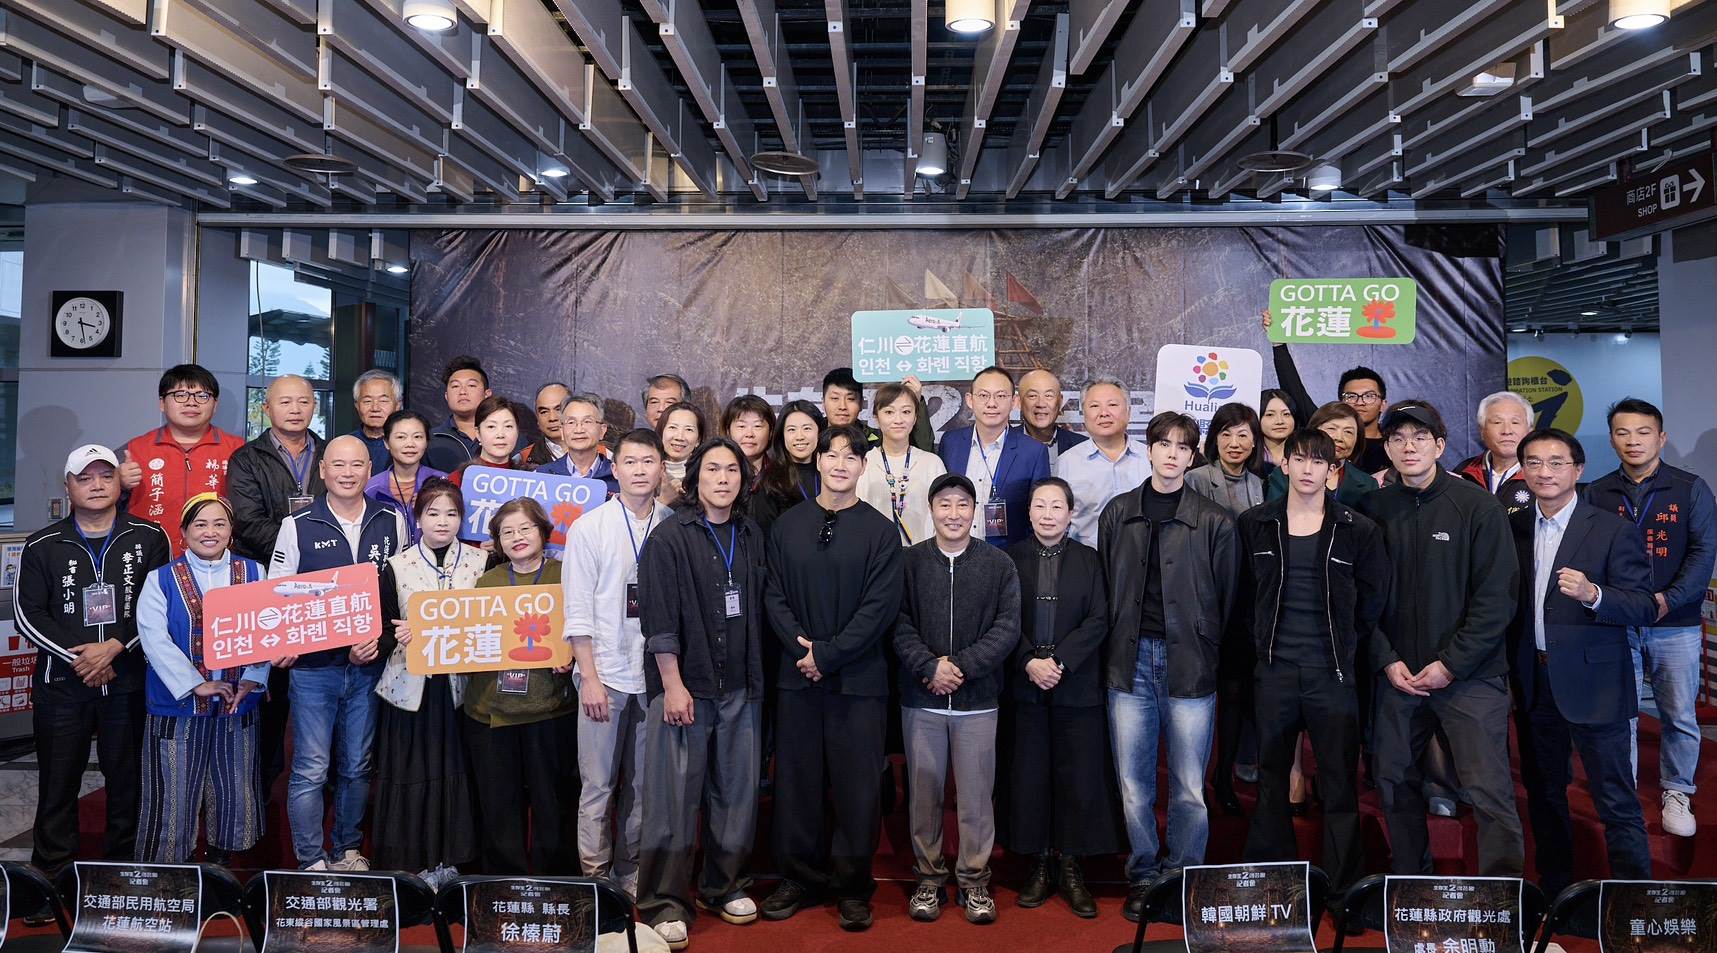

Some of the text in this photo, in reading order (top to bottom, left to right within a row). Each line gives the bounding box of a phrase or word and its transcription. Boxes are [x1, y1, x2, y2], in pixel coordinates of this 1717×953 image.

[1626, 183, 1657, 206] 商店2F
[1638, 203, 1658, 218] SHOP
[1280, 284, 1400, 302] GOTTA GO
[1280, 306, 1352, 337] 花蓮
[858, 334, 989, 355] 仁川 花蓮直航
[858, 357, 891, 375] 인천
[954, 355, 987, 373] 직항
[1184, 400, 1217, 412] Huali
[472, 473, 591, 504] GOTTA GO
[989, 518, 1003, 526] VIP
[314, 539, 338, 549] KMT
[1656, 512, 1669, 557] 邱光明
[368, 544, 381, 561] 吳
[62, 575, 76, 615] 張小明
[92, 603, 109, 614] VIP
[211, 591, 373, 638] 仁川 花蓮直航
[420, 592, 554, 621] GOTTA GO
[212, 635, 254, 660] 인천
[333, 613, 374, 636] 직항
[421, 623, 503, 668] 花蓮
[84, 894, 195, 914] 交通部民用航空局
[285, 895, 378, 911] 交通部觀光署
[492, 901, 570, 916] 花蓮縣 縣長
[1201, 904, 1292, 923] 韓國朝鮮 TV
[1394, 907, 1511, 924] 花蓮縣政府觀光處
[102, 914, 172, 934] 花蓮航空站
[500, 922, 562, 944] 徐榛蔚
[1630, 918, 1697, 937] 童心娛樂
[1414, 942, 1437, 953] 處長
